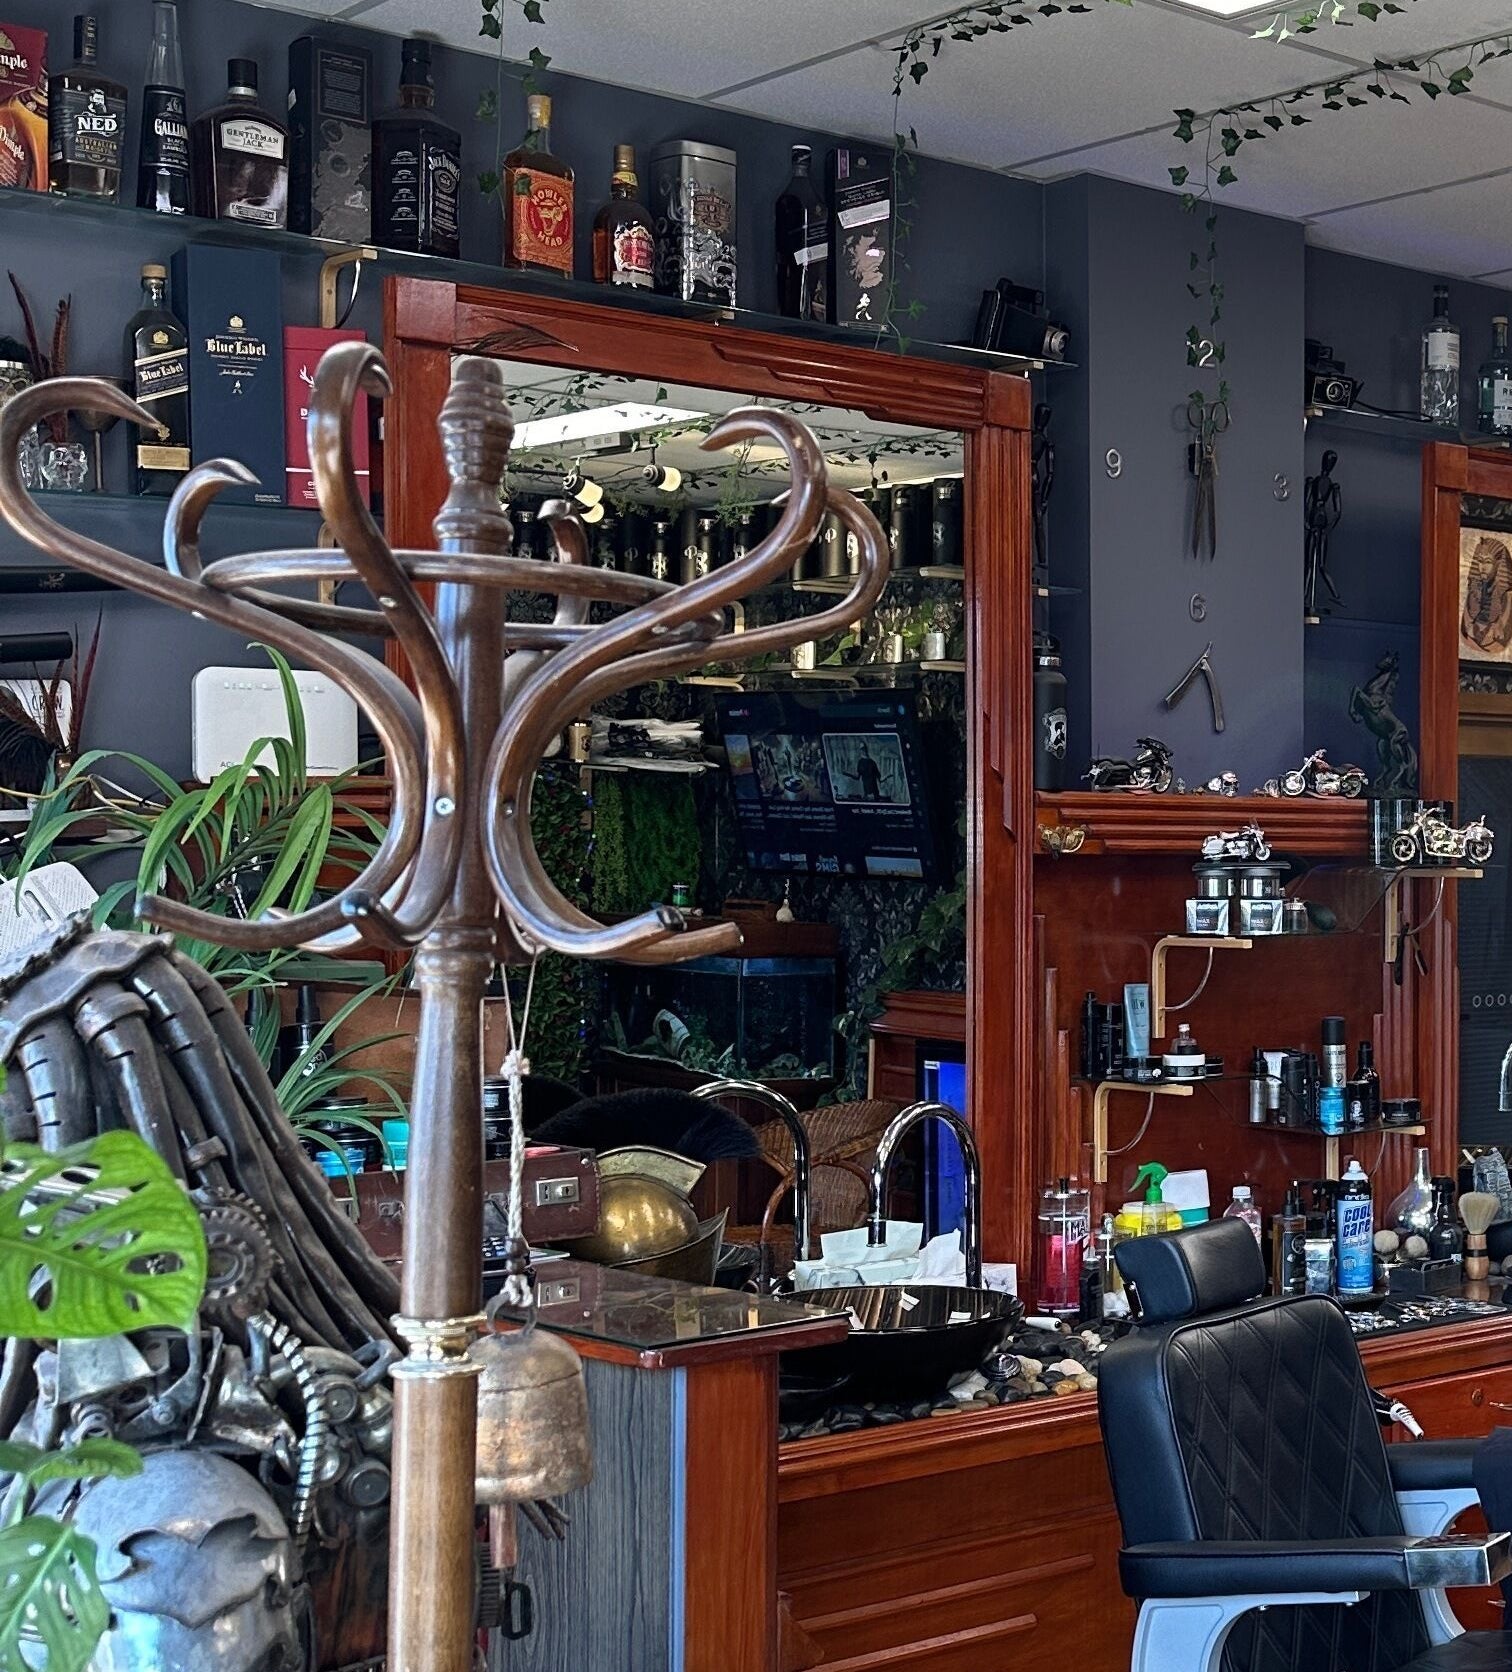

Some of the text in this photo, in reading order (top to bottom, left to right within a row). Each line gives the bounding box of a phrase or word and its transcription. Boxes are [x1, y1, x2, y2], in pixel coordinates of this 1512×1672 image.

[77, 117, 118, 132] NED
[226, 128, 279, 144] GENTLEMAN
[242, 138, 264, 148] JACK
[537, 231, 563, 247] HEAD
[204, 338, 234, 354] Blue
[234, 340, 267, 356] Label
[139, 362, 184, 383] Blue Label
[1105, 448, 1123, 479] 9
[1273, 472, 1291, 501] 3
[1188, 593, 1207, 622] 6
